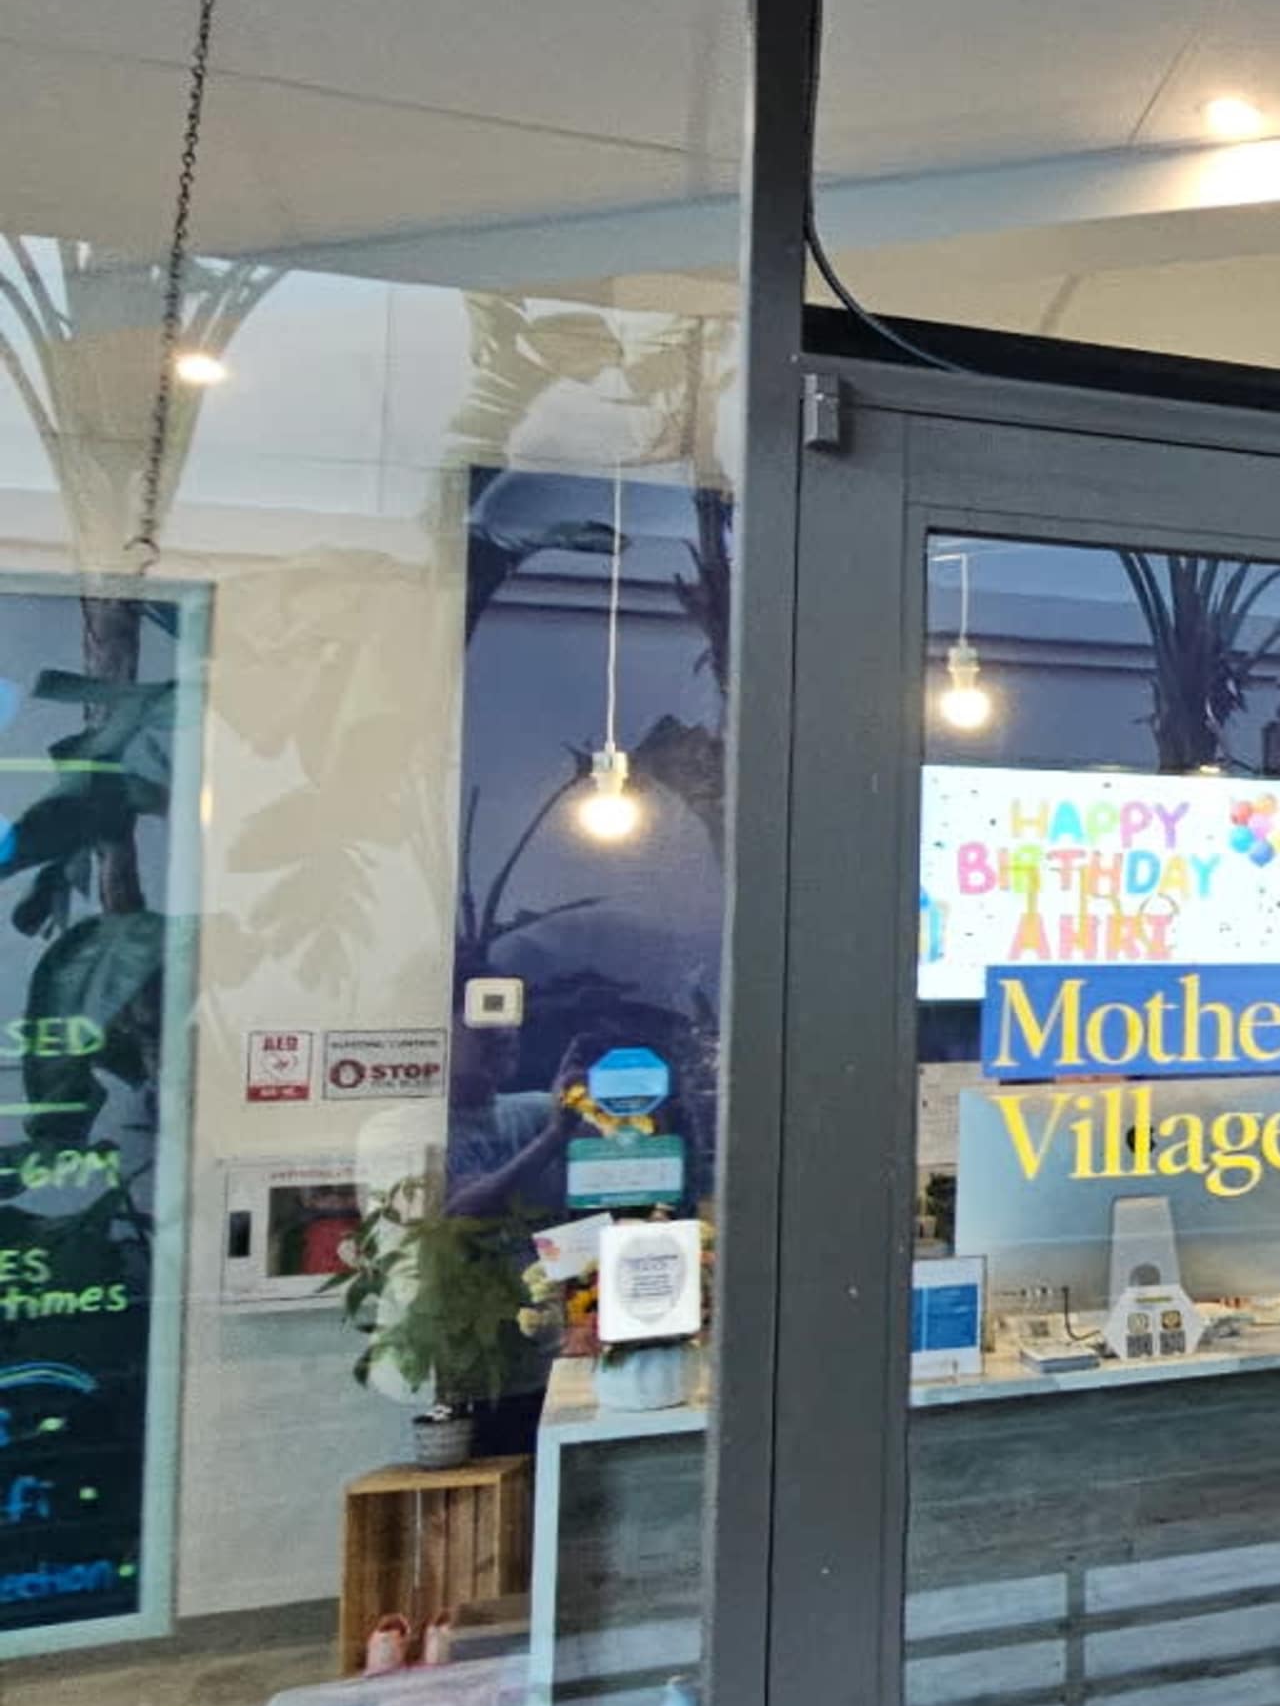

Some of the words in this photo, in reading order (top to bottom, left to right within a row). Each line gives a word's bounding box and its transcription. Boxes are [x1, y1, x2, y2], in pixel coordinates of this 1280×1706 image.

[1009, 798, 1190, 849] HAPPY
[956, 840, 1220, 899] BIRTHDAY
[369, 1062, 441, 1080] STOP
